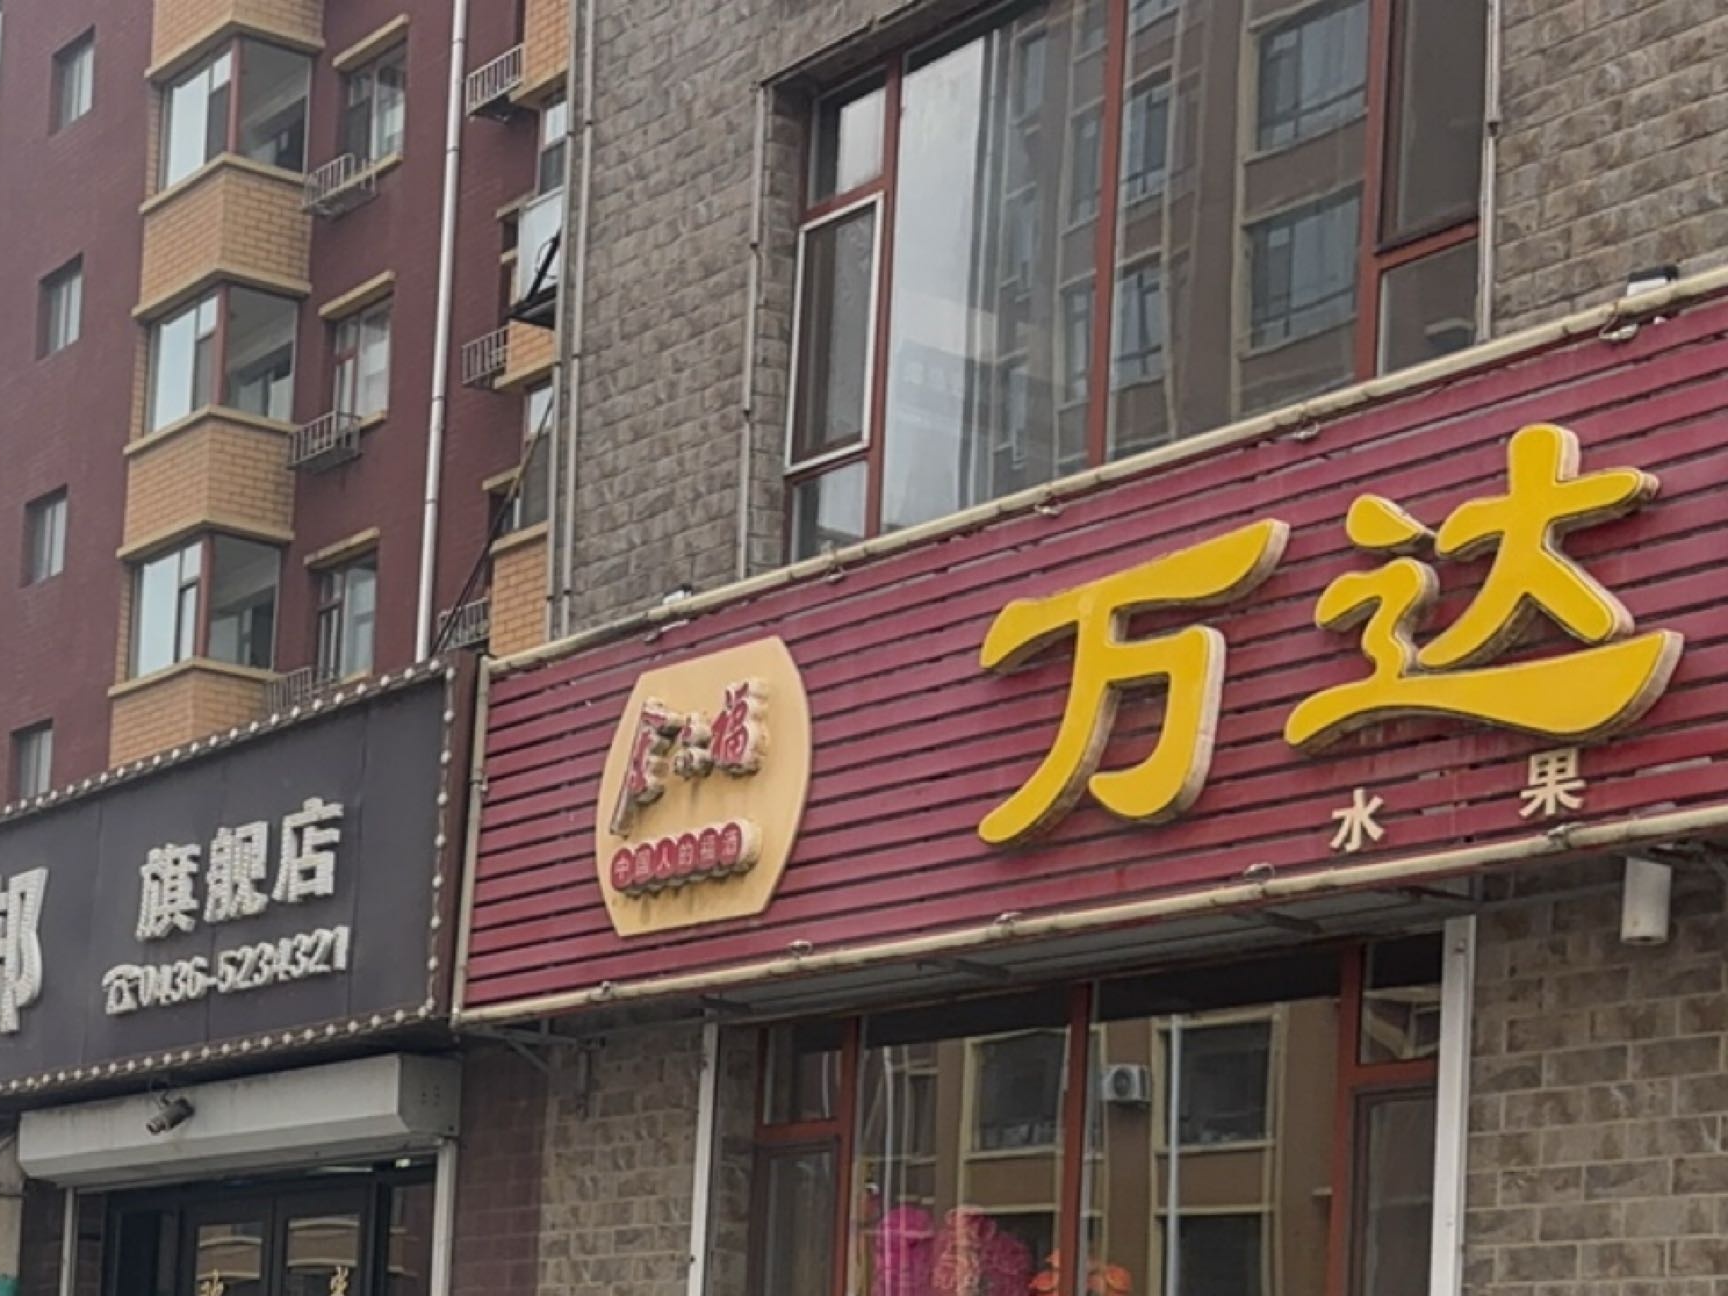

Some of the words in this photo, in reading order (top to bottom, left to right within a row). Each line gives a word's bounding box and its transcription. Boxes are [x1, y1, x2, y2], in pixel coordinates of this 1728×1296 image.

[979, 424, 1677, 844] 万达
[136, 797, 345, 940] 旗舰店
[1330, 748, 1585, 851] 水果
